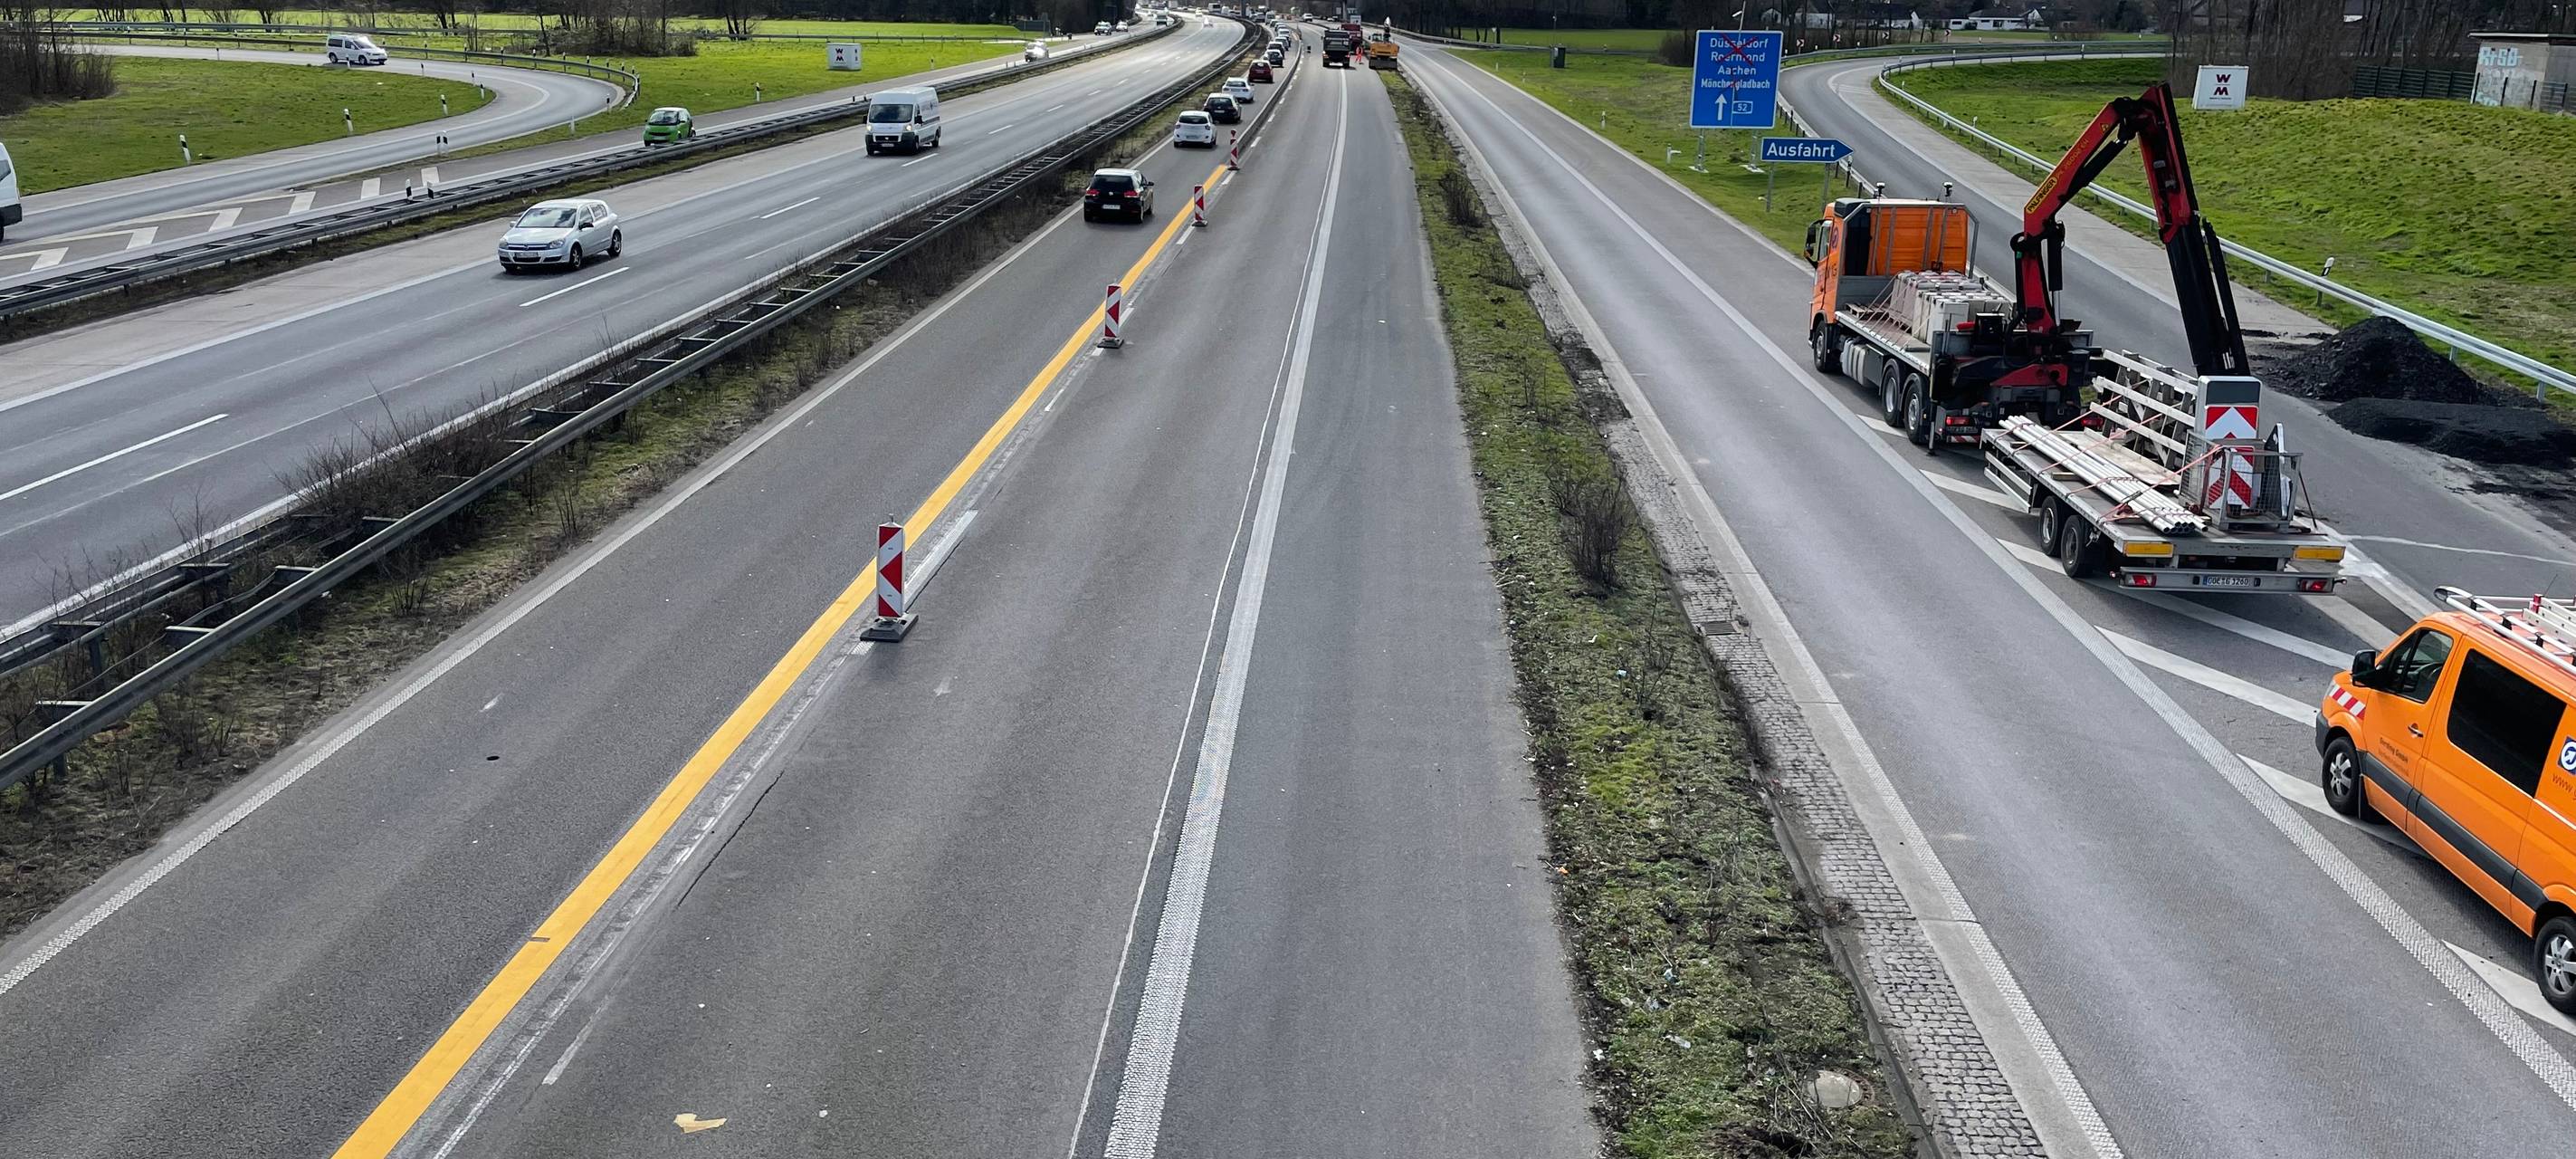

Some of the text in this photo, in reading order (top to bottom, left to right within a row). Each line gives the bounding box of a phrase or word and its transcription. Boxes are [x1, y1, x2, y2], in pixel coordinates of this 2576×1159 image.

[1710, 38, 1769, 48] Düsseldorf
[1711, 52, 1766, 62] Roermond
[1717, 65, 1757, 75] Aachen
[2216, 73, 2231, 83] W
[1701, 78, 1770, 91] Mönchengladbach
[2213, 86, 2228, 96] M
[1737, 103, 1748, 111] 52
[1766, 142, 1835, 158] Ausfahrt
